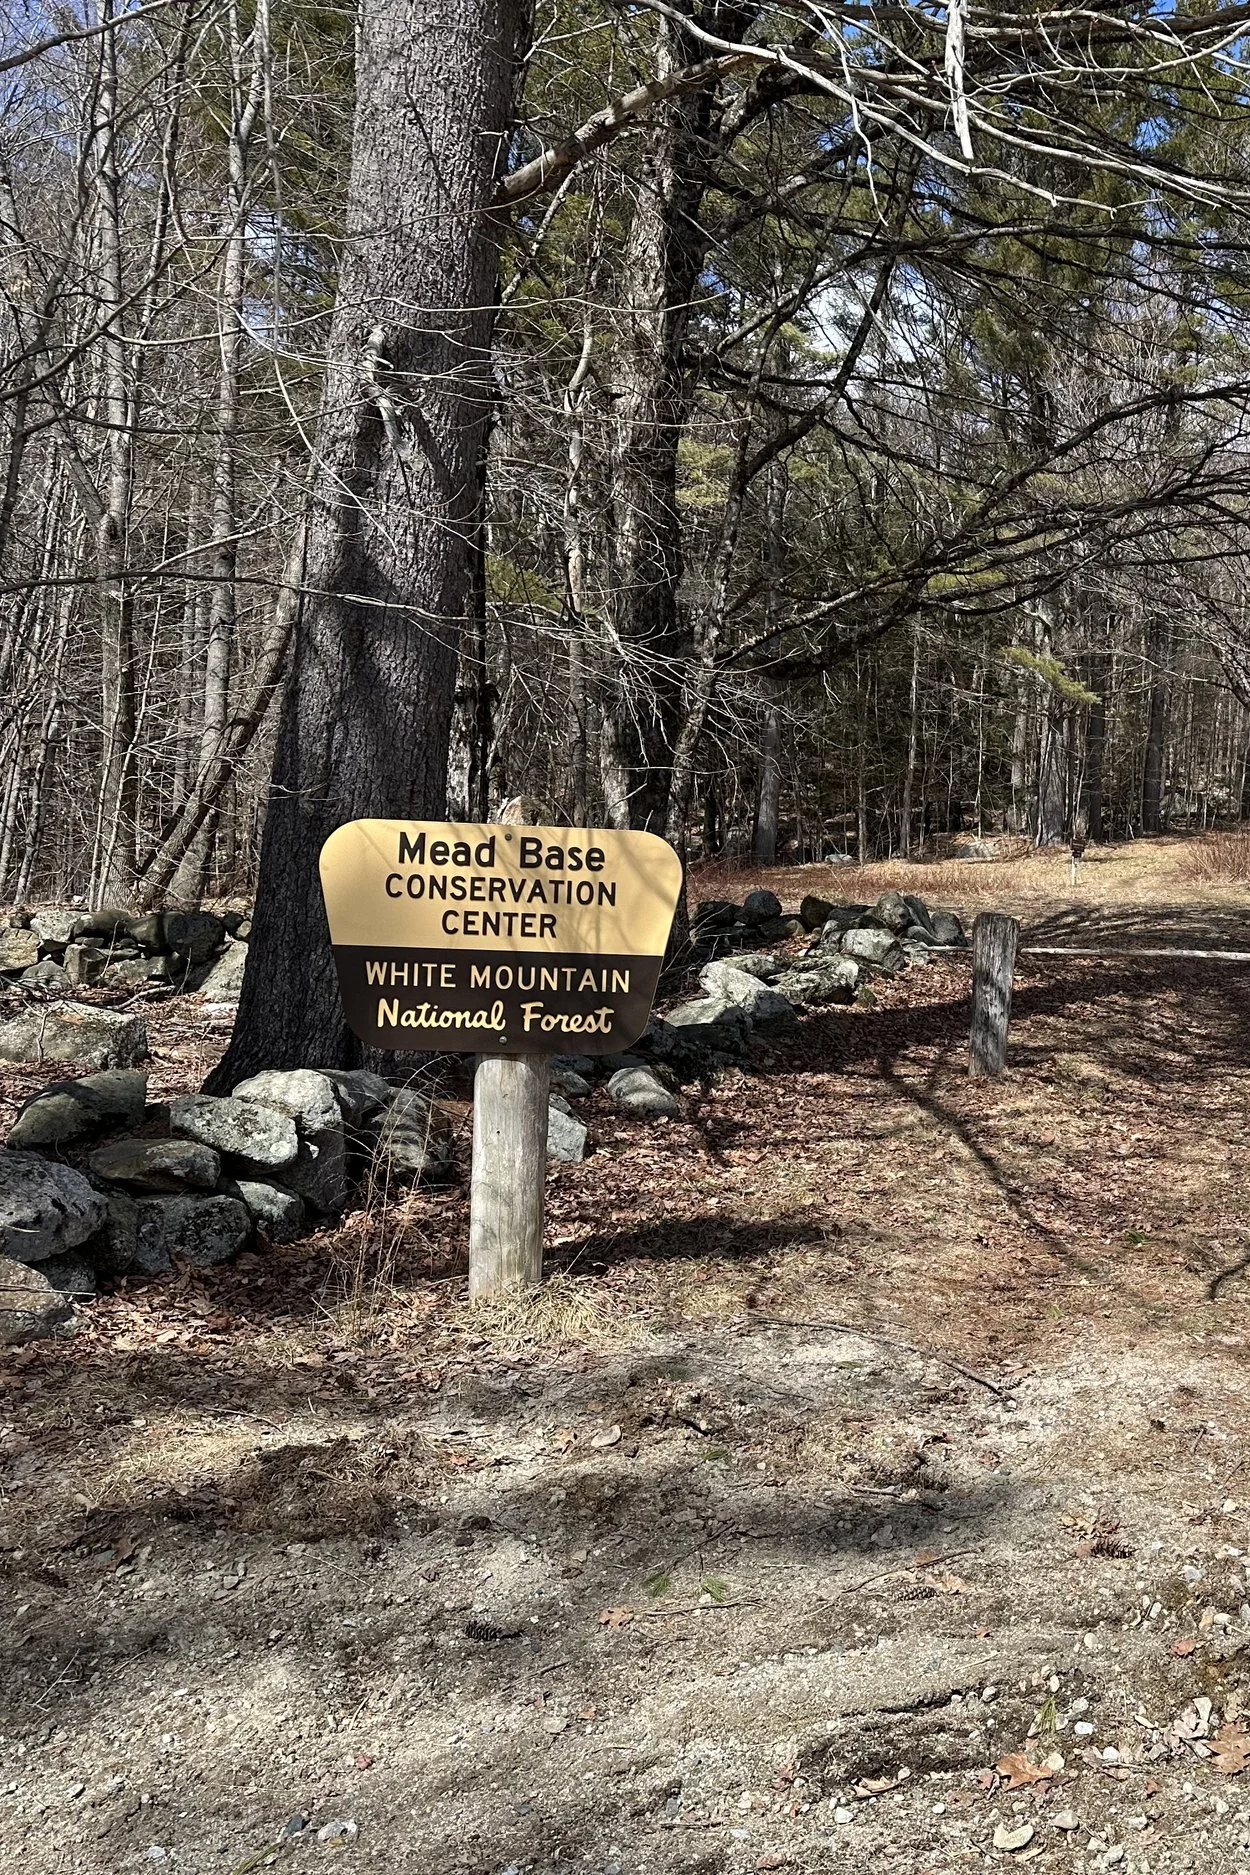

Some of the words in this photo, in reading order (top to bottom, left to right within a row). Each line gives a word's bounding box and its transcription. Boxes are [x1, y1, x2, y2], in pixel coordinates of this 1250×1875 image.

[398, 831, 496, 868] Mead
[519, 836, 606, 872] Base
[385, 873, 617, 907] CONSERVATION
[441, 909, 557, 938] CENTER
[365, 961, 456, 988] WHITE
[470, 965, 631, 993] MOUNTAIN
[377, 998, 506, 1031] National
[520, 1001, 615, 1034] Forest
